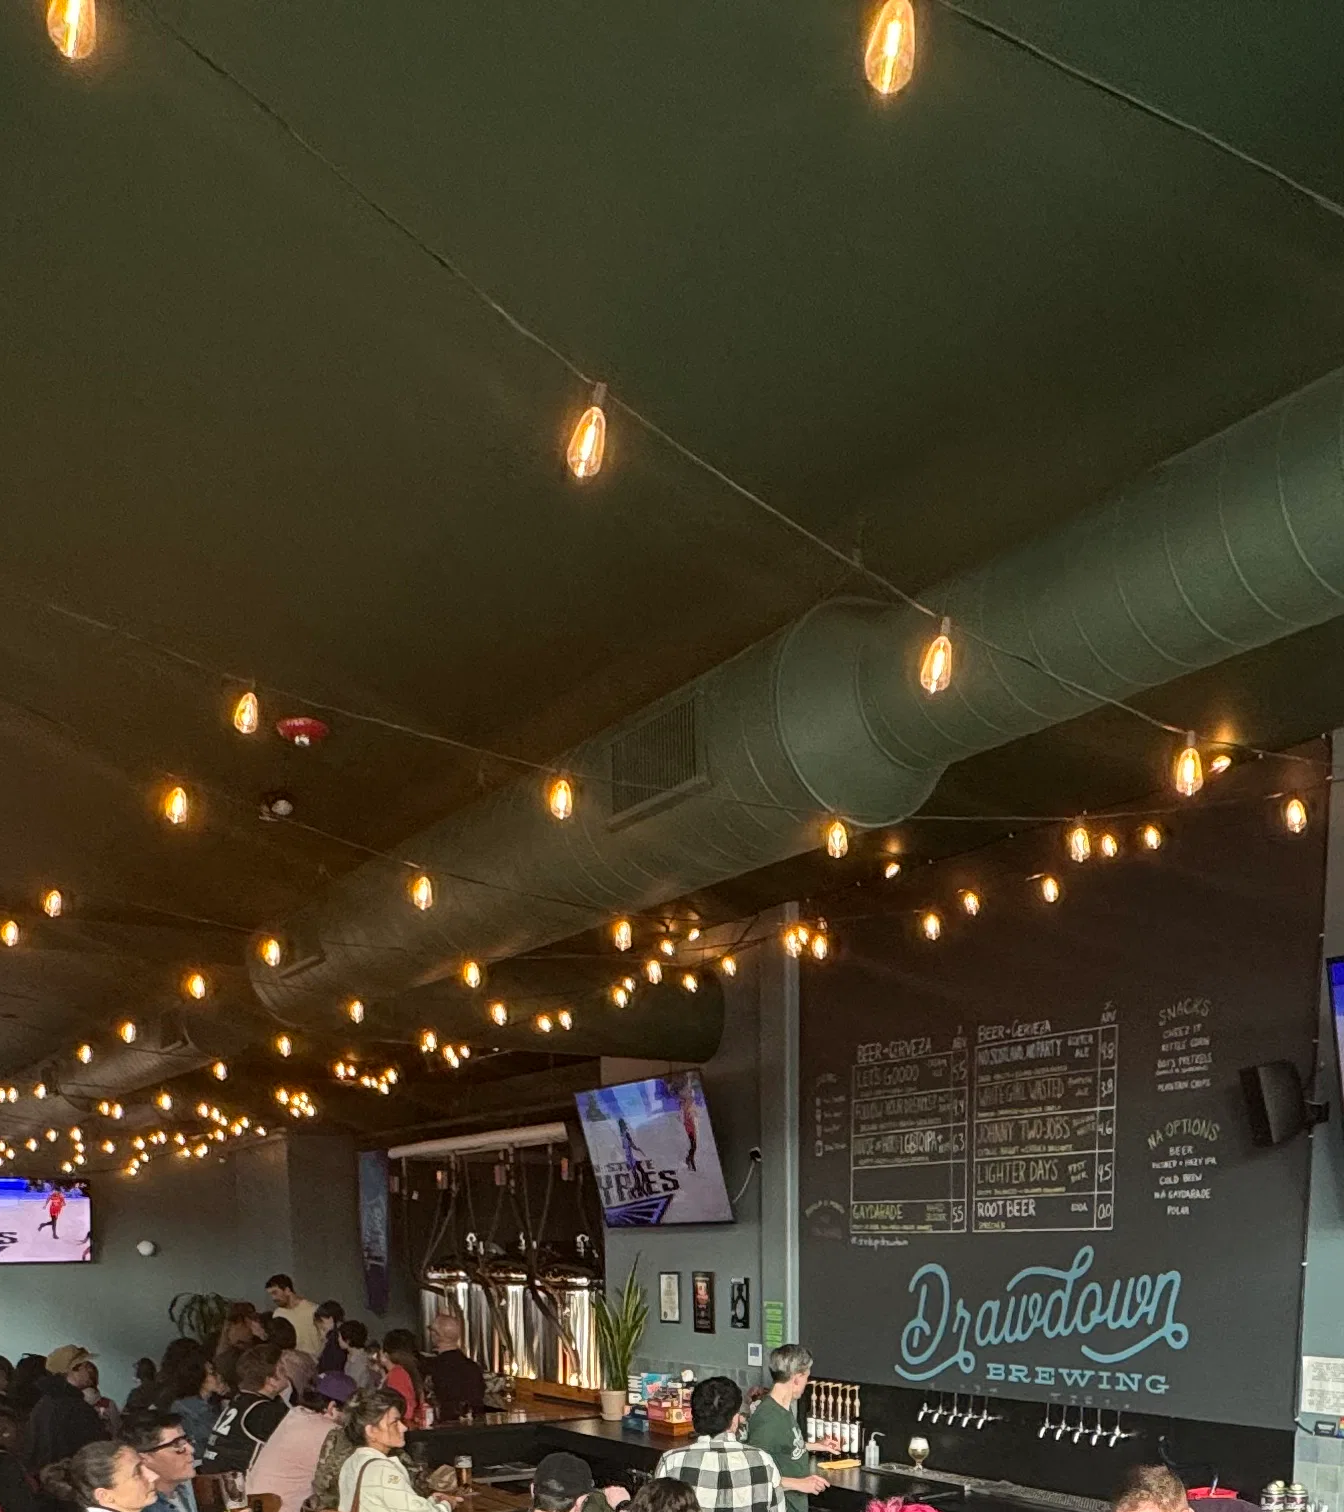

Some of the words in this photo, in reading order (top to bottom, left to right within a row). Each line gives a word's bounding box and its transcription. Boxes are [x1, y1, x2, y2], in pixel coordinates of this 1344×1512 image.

[1159, 997, 1212, 1026] SNACKS
[978, 1025, 1004, 1042] BEER
[857, 1042, 882, 1062] BEER
[1165, 1118, 1220, 1141] OPTIONS
[1169, 1145, 1193, 1156] BEER
[977, 1160, 1026, 1184] LIGHTER
[1029, 1159, 1059, 1182] DAYS
[1159, 1175, 1179, 1186] COLD
[596, 1170, 680, 1205] YRES
[977, 1200, 1004, 1218] ROOT
[1006, 1199, 1036, 1218] BEER
[895, 1247, 1189, 1381] Drawdown
[985, 1362, 1170, 1395] BREWING
